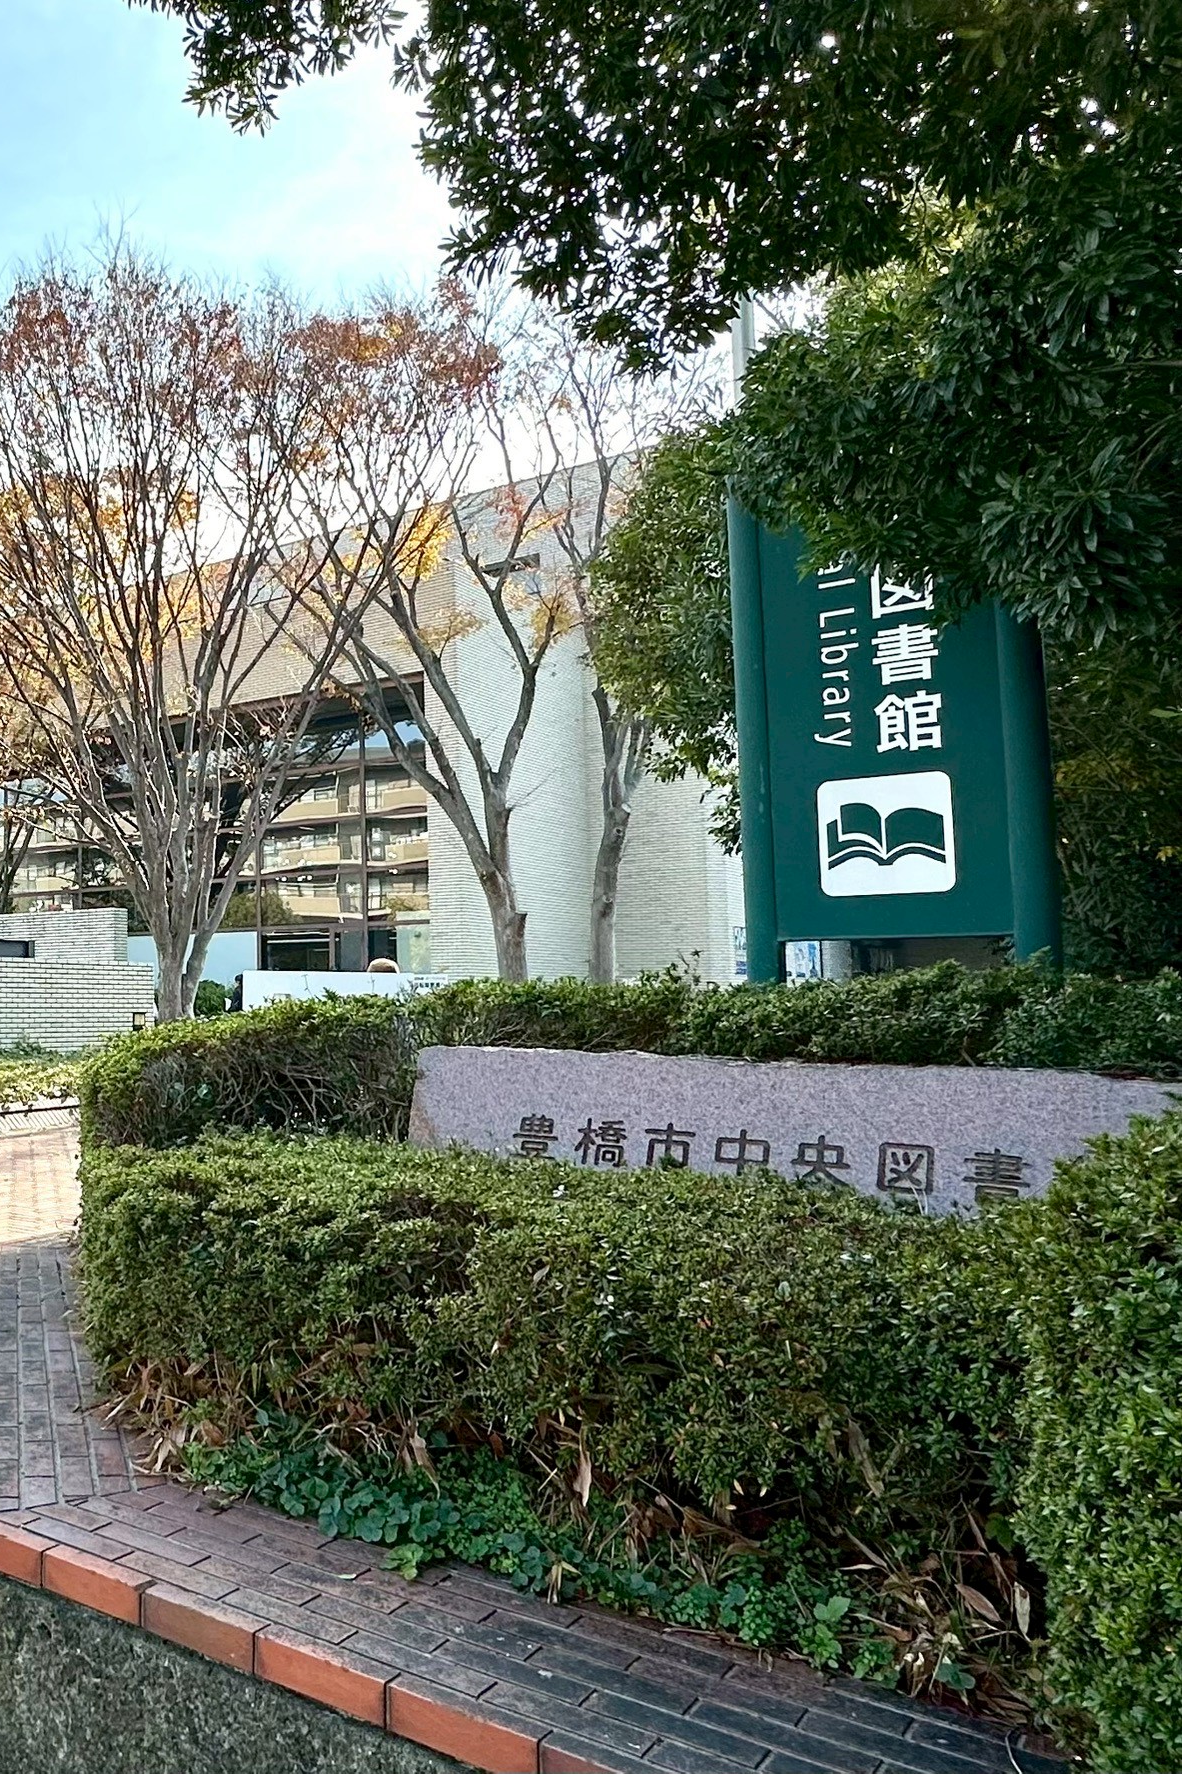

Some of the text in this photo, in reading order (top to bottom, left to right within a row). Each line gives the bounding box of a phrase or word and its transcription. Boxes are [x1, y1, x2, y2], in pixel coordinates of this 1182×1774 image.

[814, 607, 859, 747] Library
[511, 1113, 1031, 1200] 豊橋市中央図書
